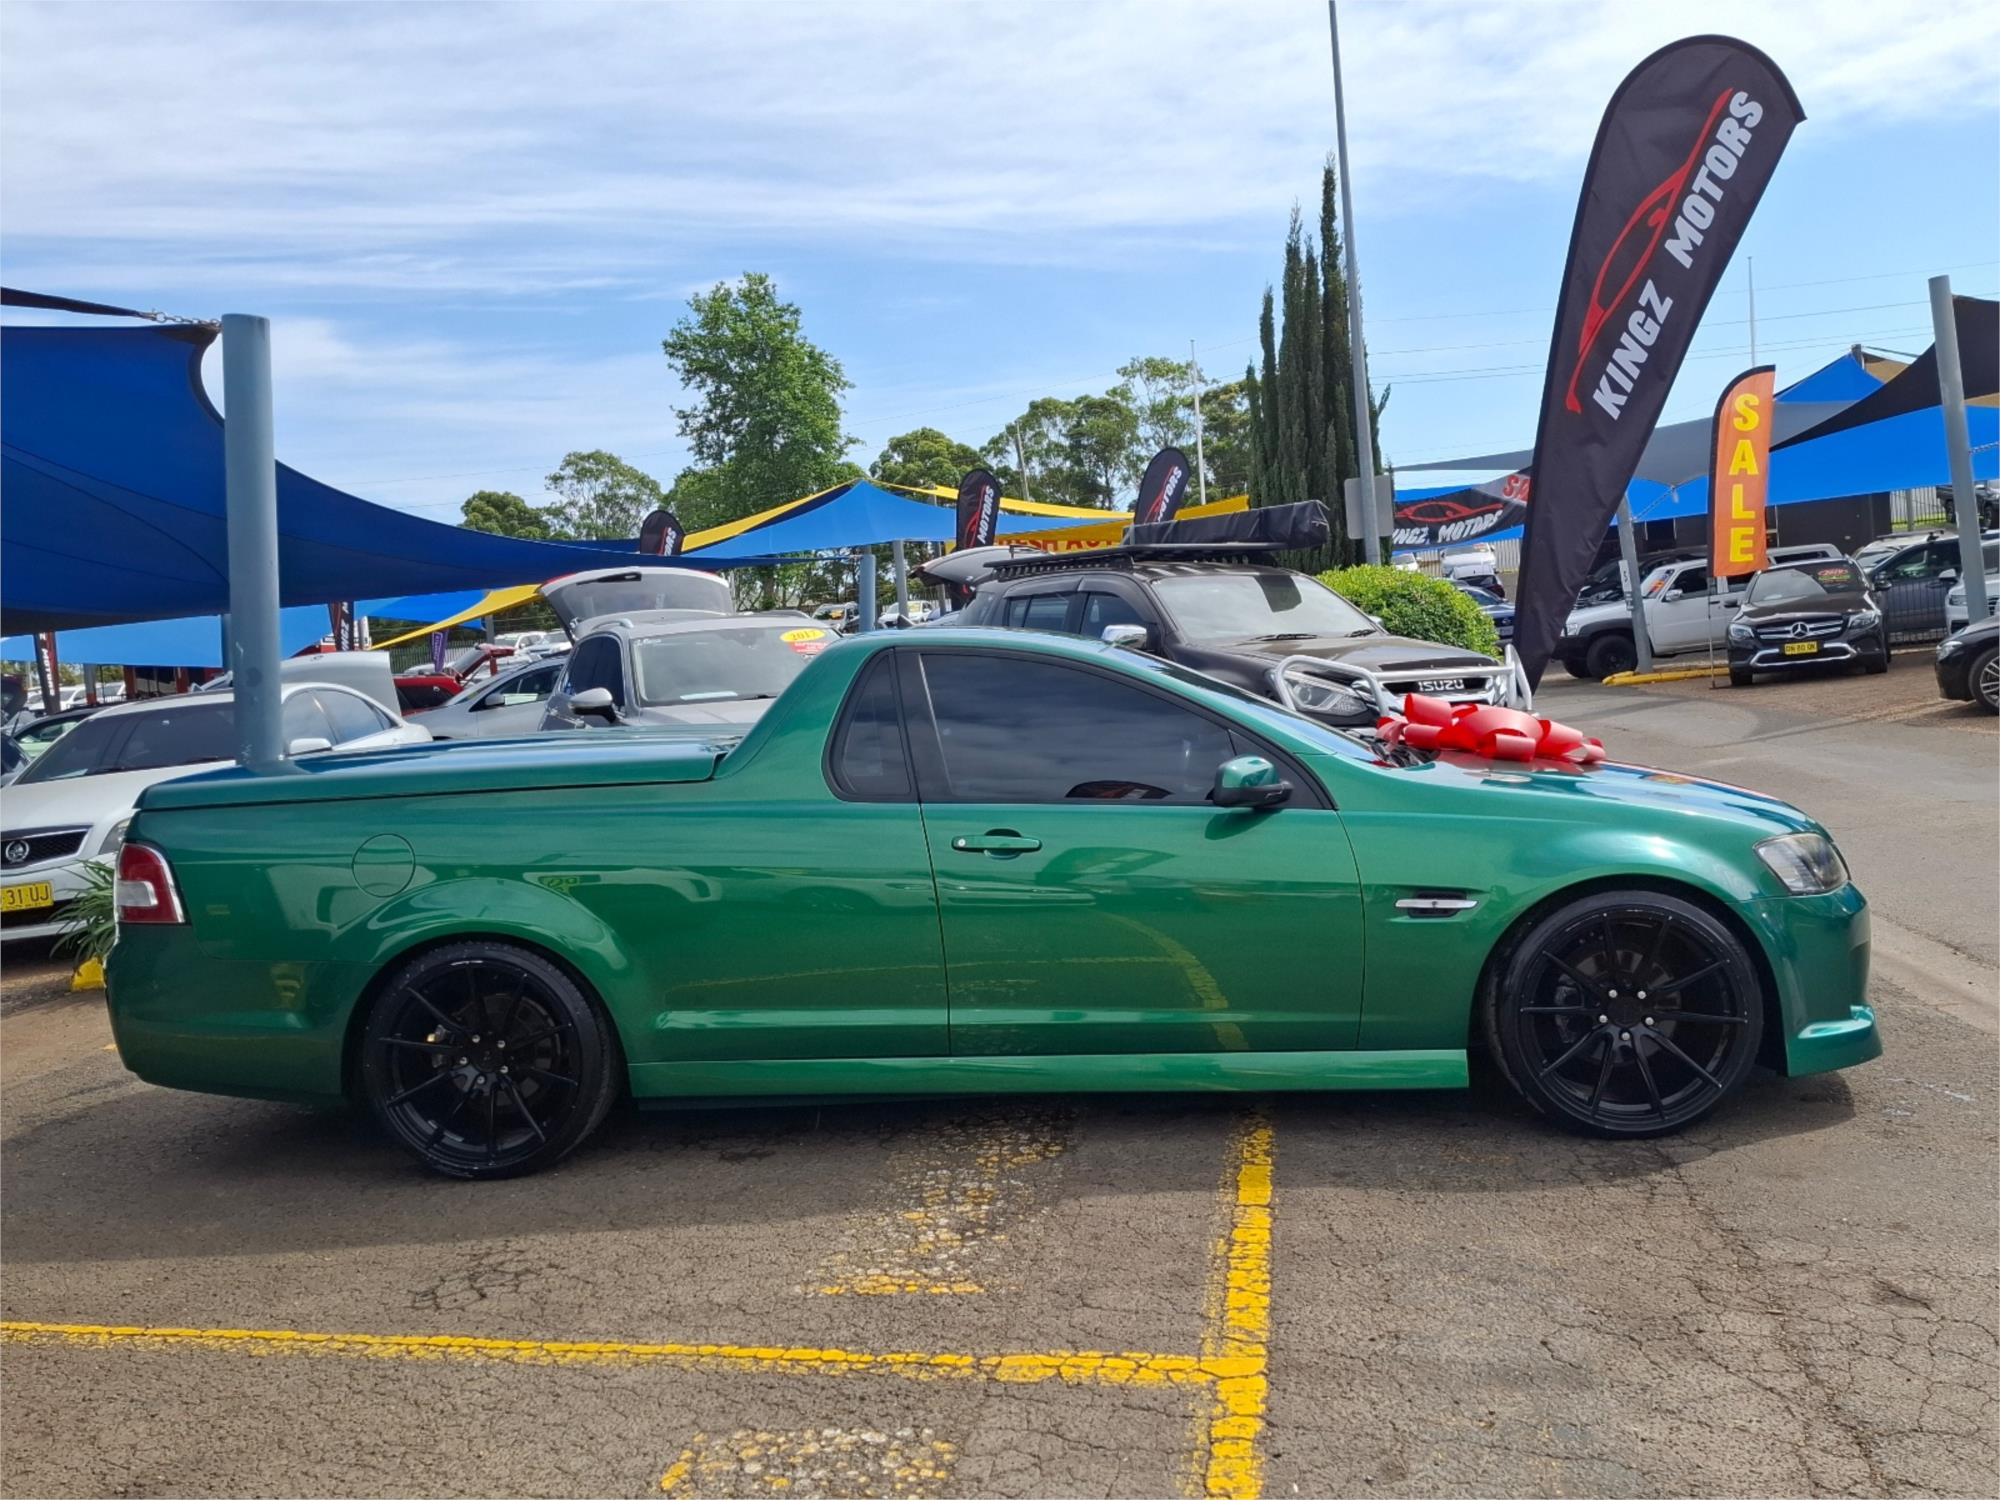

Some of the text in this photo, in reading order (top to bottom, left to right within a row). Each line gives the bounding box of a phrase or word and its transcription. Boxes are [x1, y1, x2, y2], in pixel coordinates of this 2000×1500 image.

[1592, 91, 1764, 420] KINGZ MOTORS
[1728, 393, 1760, 562] SALE
[977, 485, 995, 544] MOTORS
[1418, 679, 1465, 692] ISUZU
[6, 884, 49, 905] 31 UJ
